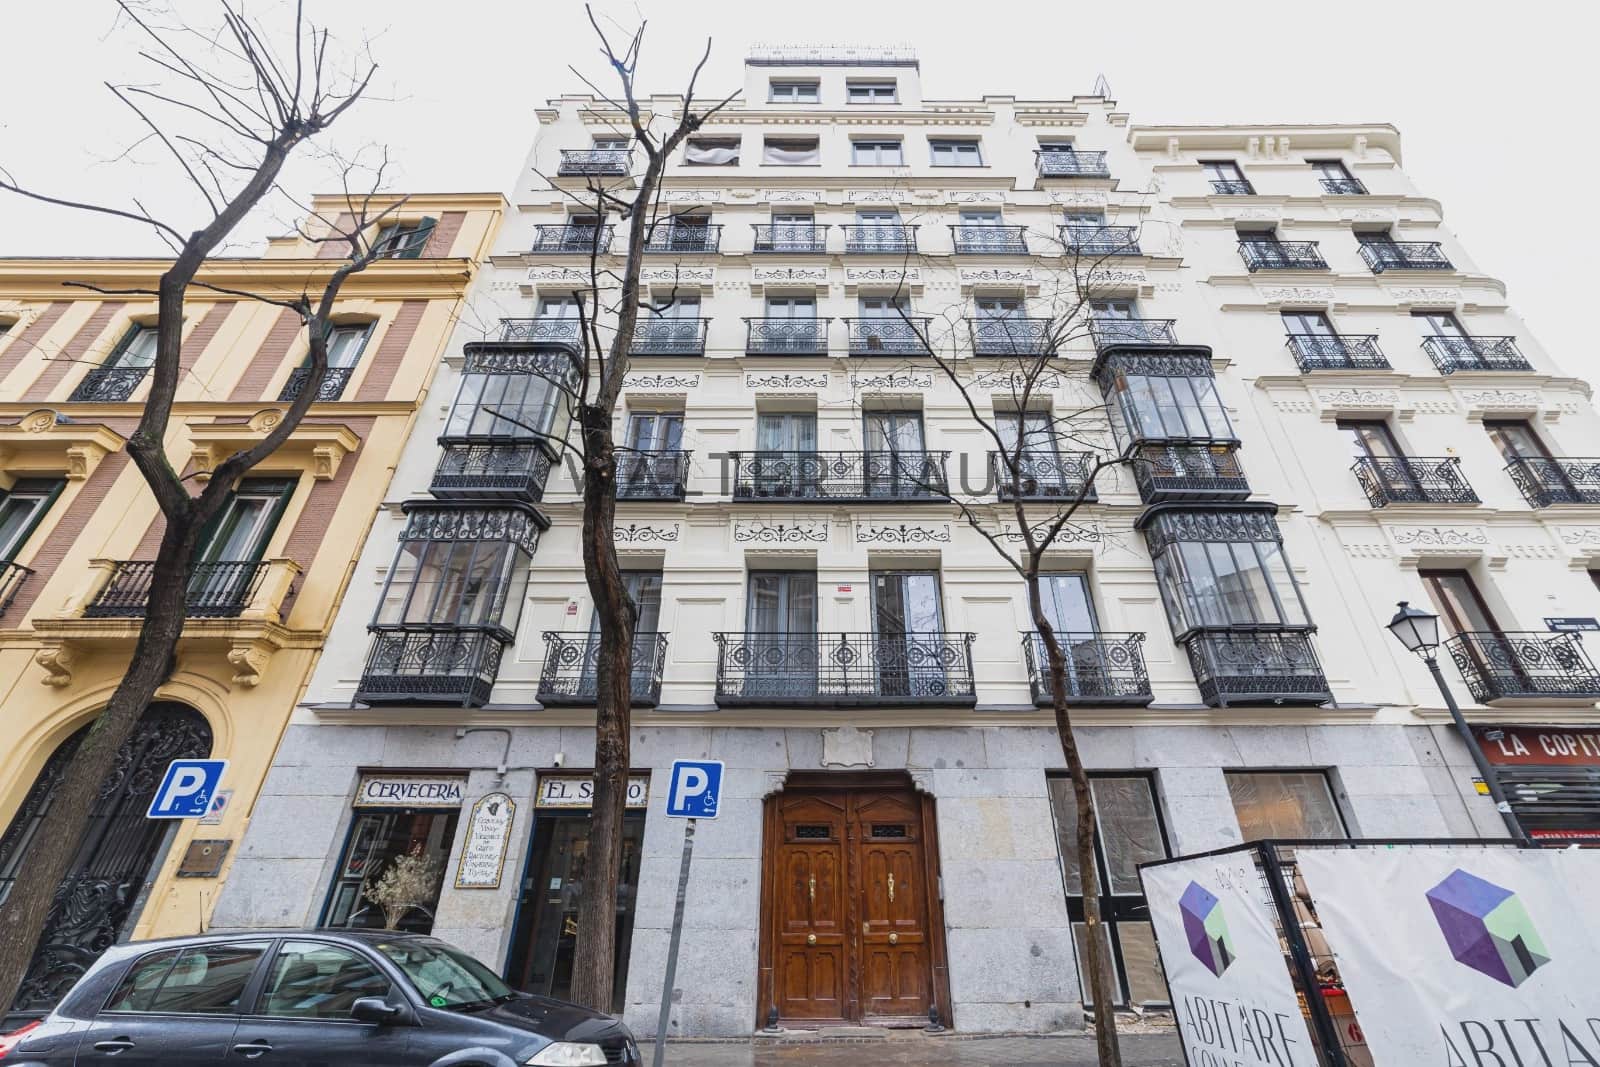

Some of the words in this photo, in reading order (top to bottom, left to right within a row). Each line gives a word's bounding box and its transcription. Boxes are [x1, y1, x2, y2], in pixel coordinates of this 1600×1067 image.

[1496, 734, 1531, 757] LA
[1538, 734, 1600, 757] COPIT
[158, 767, 207, 811] P
[544, 782, 572, 799] EL
[673, 767, 708, 811] P
[1184, 994, 1297, 1067] ABITARE
[1440, 1018, 1600, 1067] ABITA
